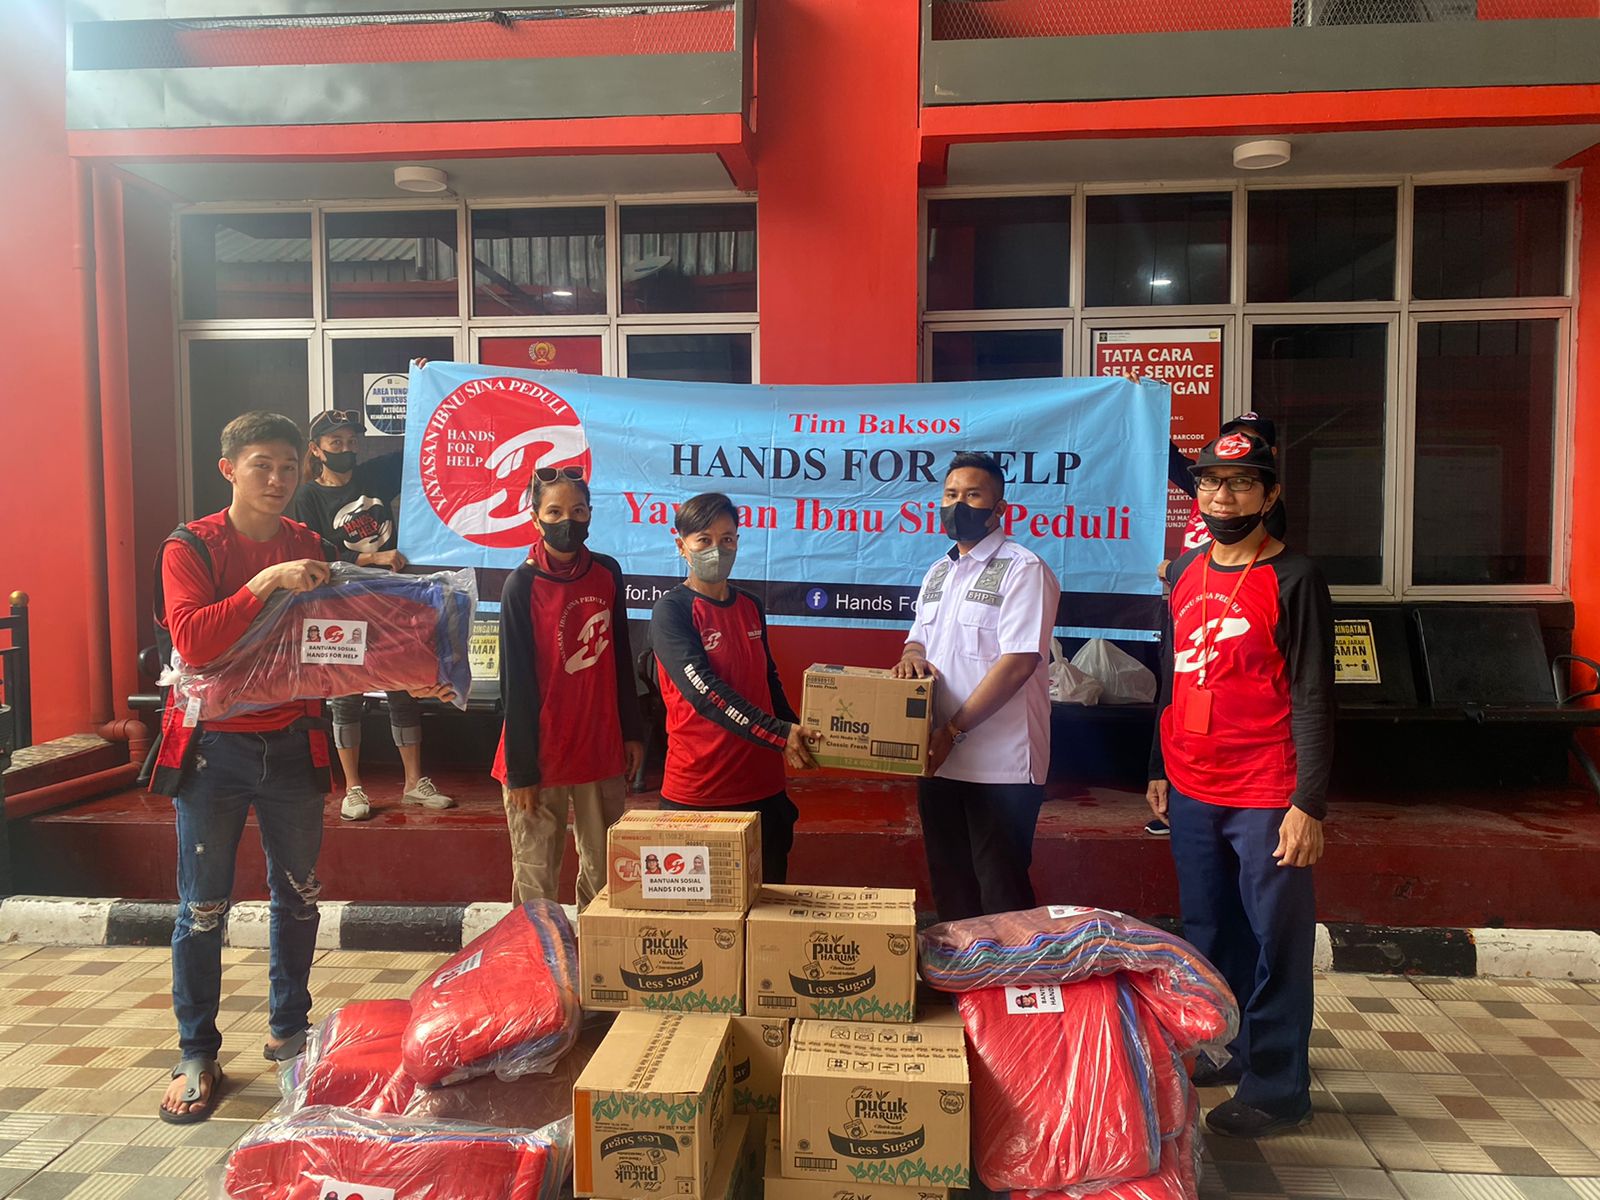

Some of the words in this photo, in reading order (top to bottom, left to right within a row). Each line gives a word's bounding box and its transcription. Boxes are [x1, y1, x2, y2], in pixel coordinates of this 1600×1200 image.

[1102, 348, 1143, 363] TATA
[1147, 347, 1193, 362] CARA
[1144, 364, 1214, 378] SERVICE
[465, 380, 505, 398] SINA
[509, 380, 569, 417] PEDULI
[432, 391, 466, 430] IBNU
[789, 413, 846, 434] Tim
[858, 414, 961, 435] Baksos
[447, 429, 495, 442] HANDS
[447, 443, 475, 454] FOR
[422, 429, 448, 511] YAYASAN
[446, 456, 484, 467] HELP
[670, 443, 827, 481] HANDS
[840, 448, 938, 483] FOR
[952, 450, 1082, 485] ELP
[622, 491, 778, 534] Yaan
[792, 498, 884, 532] Ibnu
[1003, 503, 1130, 540] Peduli
[835, 593, 892, 611] Hands
[1195, 592, 1213, 603] SIA
[683, 663, 709, 695] HANDS
[707, 691, 726, 709] FOR
[725, 705, 749, 726] HELP
[830, 715, 870, 734] Rinso
[826, 740, 849, 749] Classic
[642, 935, 688, 954] pucuk
[650, 948, 686, 956] HARUM
[812, 940, 860, 960] pucuk
[821, 954, 858, 962] HARUM
[638, 977, 663, 989] Less
[666, 970, 700, 986] Sugar
[808, 983, 835, 995] Less
[837, 976, 872, 992] Sugar
[855, 1097, 909, 1118] pucuk
[863, 1111, 905, 1120] HARUM
[604, 1135, 635, 1151] Sugar
[637, 1134, 662, 1145] Less
[850, 1142, 879, 1155] Less
[882, 1136, 920, 1153] Sugar
[615, 1165, 658, 1183] pucuk
[618, 1163, 651, 1171] HARUM
